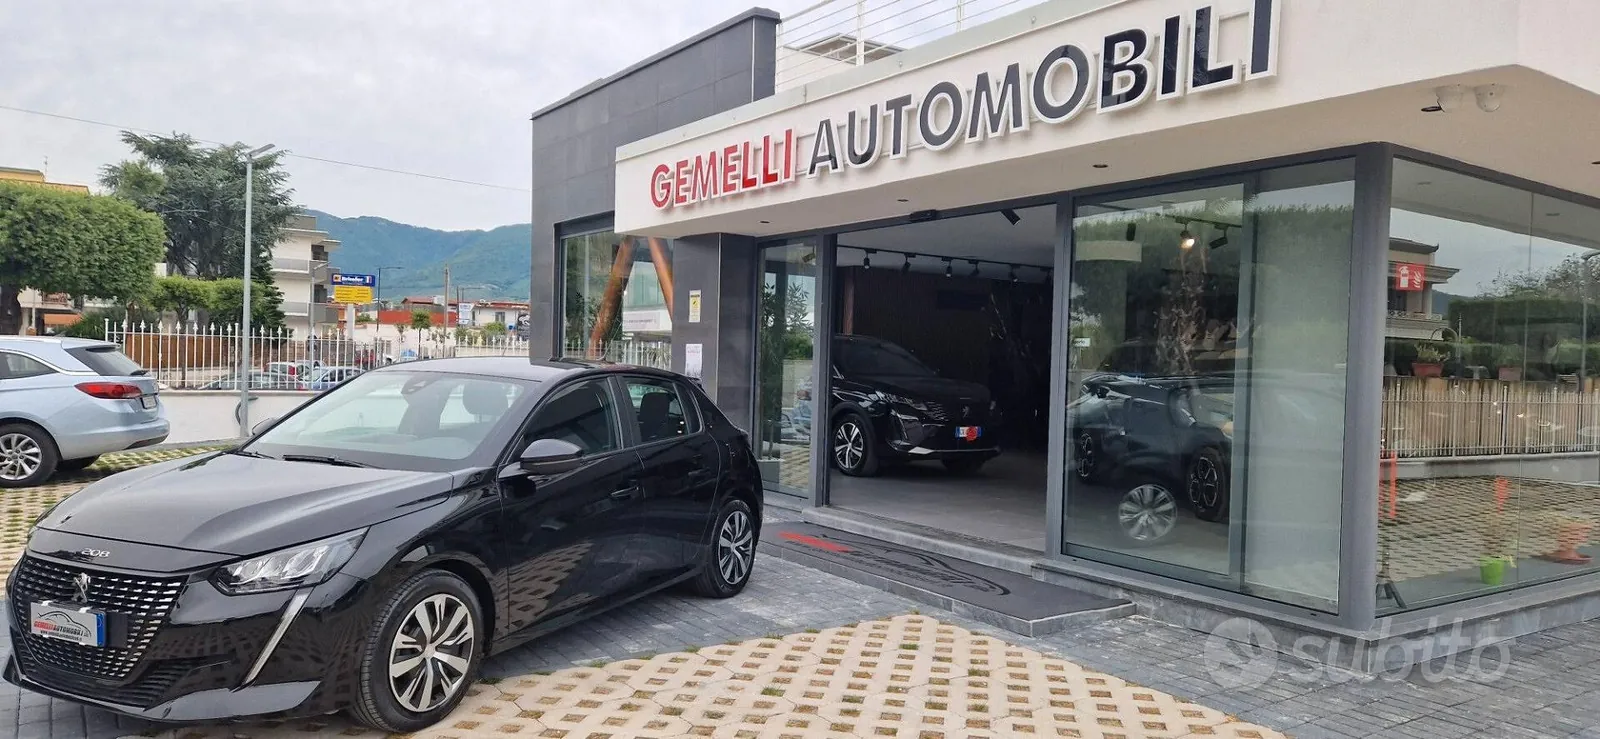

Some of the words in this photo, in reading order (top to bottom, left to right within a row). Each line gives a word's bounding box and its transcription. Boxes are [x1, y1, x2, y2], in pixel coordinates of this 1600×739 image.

[650, 129, 794, 209] GEMELLI
[807, 0, 1276, 177] AUTOMOBILI
[81, 547, 110, 557] 208
